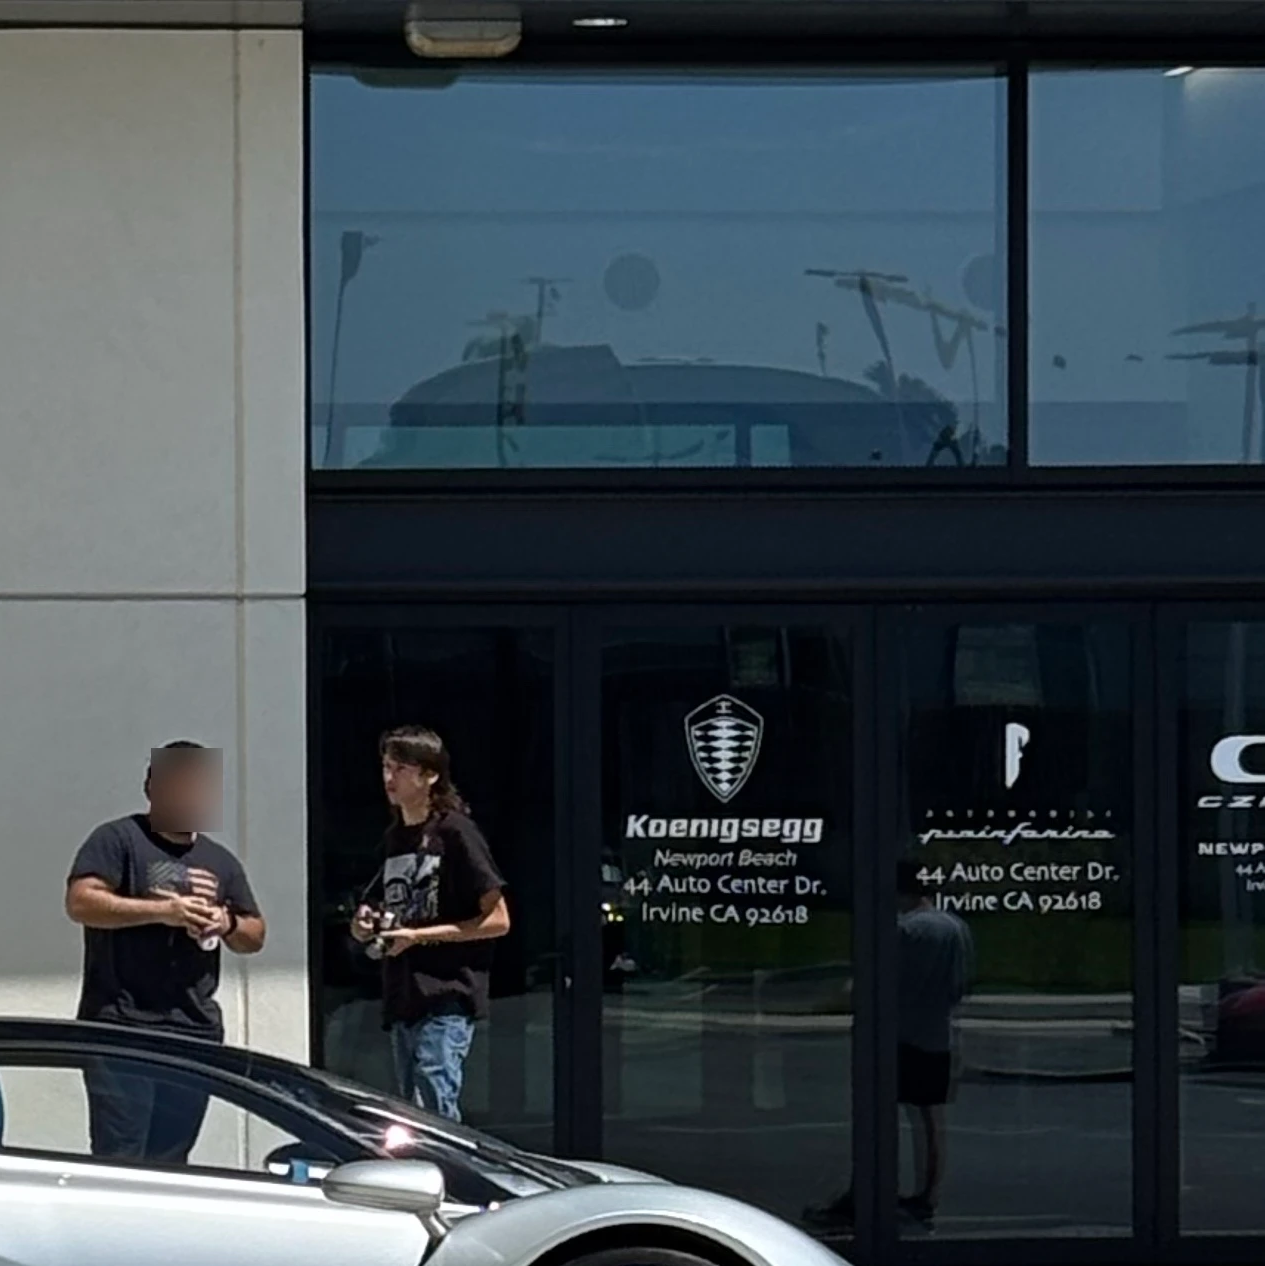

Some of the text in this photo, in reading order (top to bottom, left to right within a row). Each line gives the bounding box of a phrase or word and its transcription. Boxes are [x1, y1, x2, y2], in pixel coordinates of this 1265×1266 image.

[625, 814, 823, 843] Koenigsegg
[654, 849, 797, 869] Newport Beach
[916, 862, 1120, 885] 44 Auto Center Dr.
[624, 875, 827, 896] 44 Auto Center Dr.
[642, 902, 808, 926] Irvine CA 92618
[936, 892, 1102, 914] Irvine CA 92618
